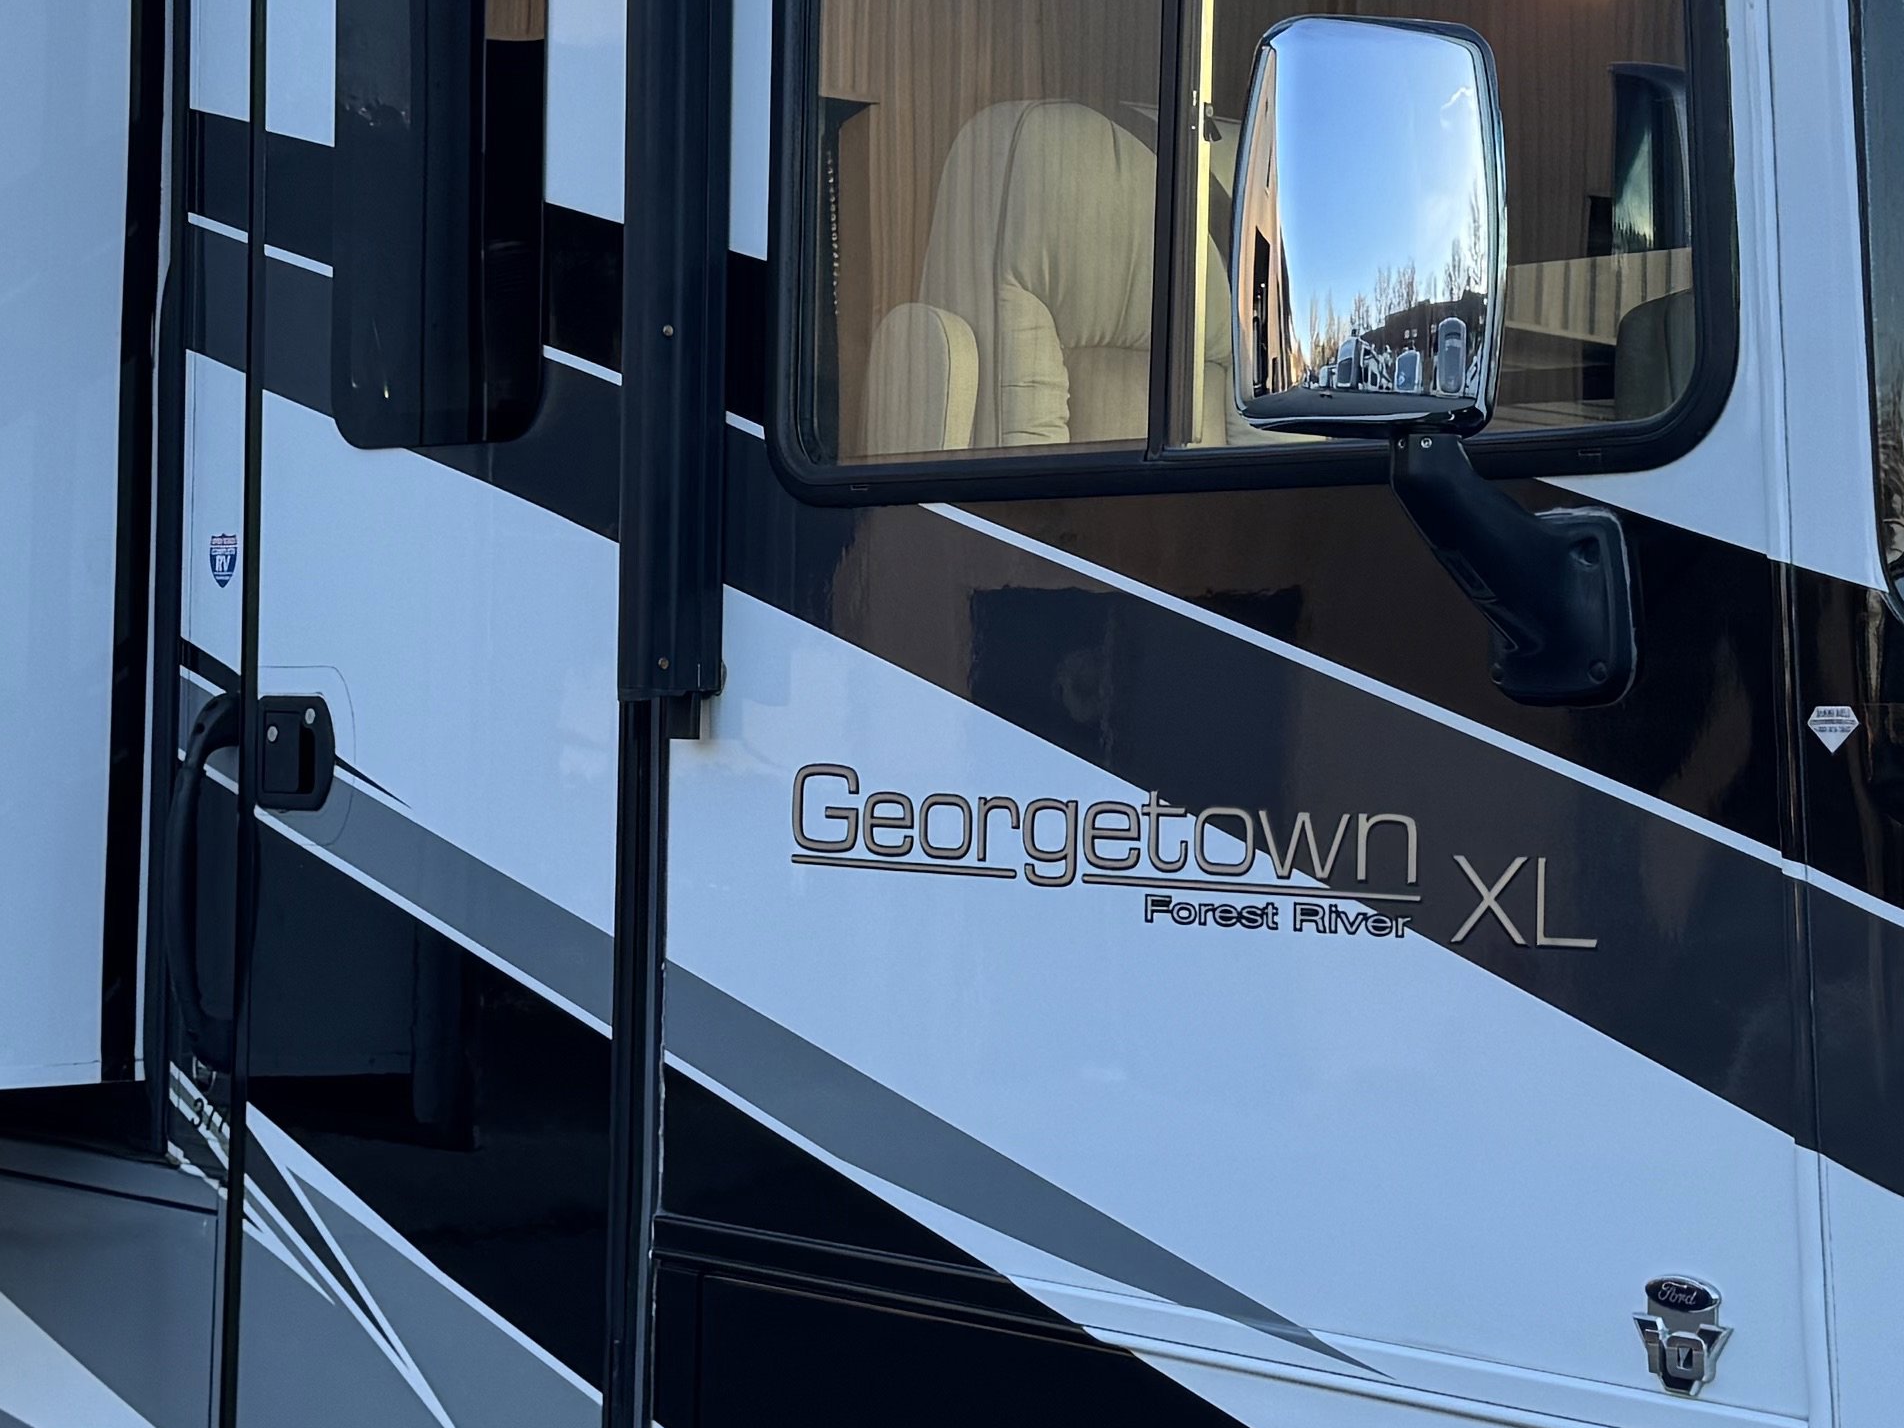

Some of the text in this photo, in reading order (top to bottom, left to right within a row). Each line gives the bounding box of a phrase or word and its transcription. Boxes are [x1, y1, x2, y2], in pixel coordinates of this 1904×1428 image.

[792, 763, 1598, 949] Georgetown XL
[1145, 893, 1411, 939] Forest River
[1657, 1281, 1697, 1306] Ford
